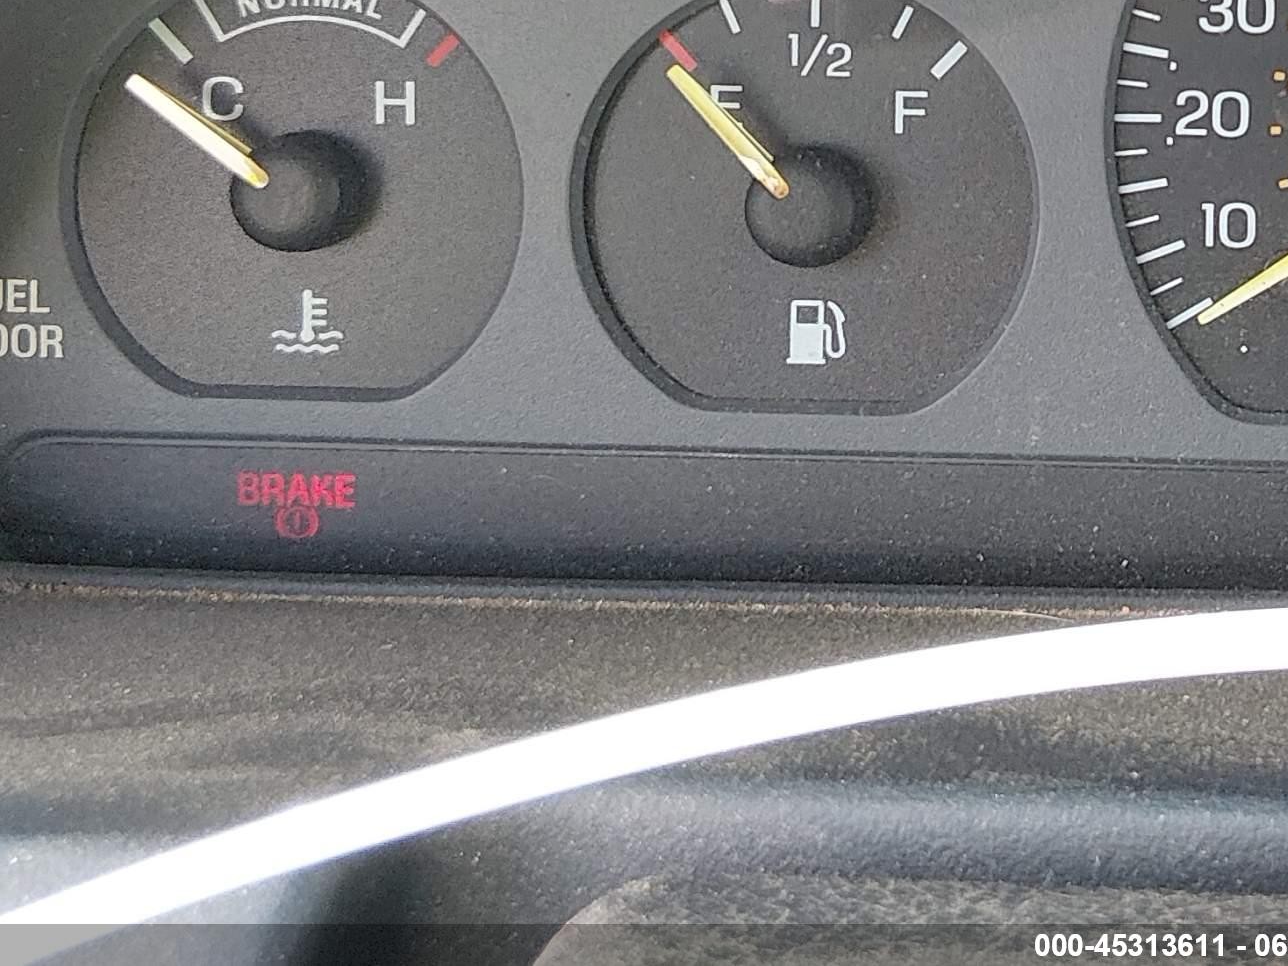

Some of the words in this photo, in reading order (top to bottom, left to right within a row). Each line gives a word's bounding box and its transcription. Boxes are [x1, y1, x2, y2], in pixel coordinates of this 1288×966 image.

[786, 33, 852, 77] 1/2
[202, 75, 245, 122] C
[375, 81, 415, 125] H
[895, 91, 928, 133] F
[1176, 90, 1249, 137] 20
[1202, 203, 1255, 248] 10
[237, 471, 356, 507] BRAKE
